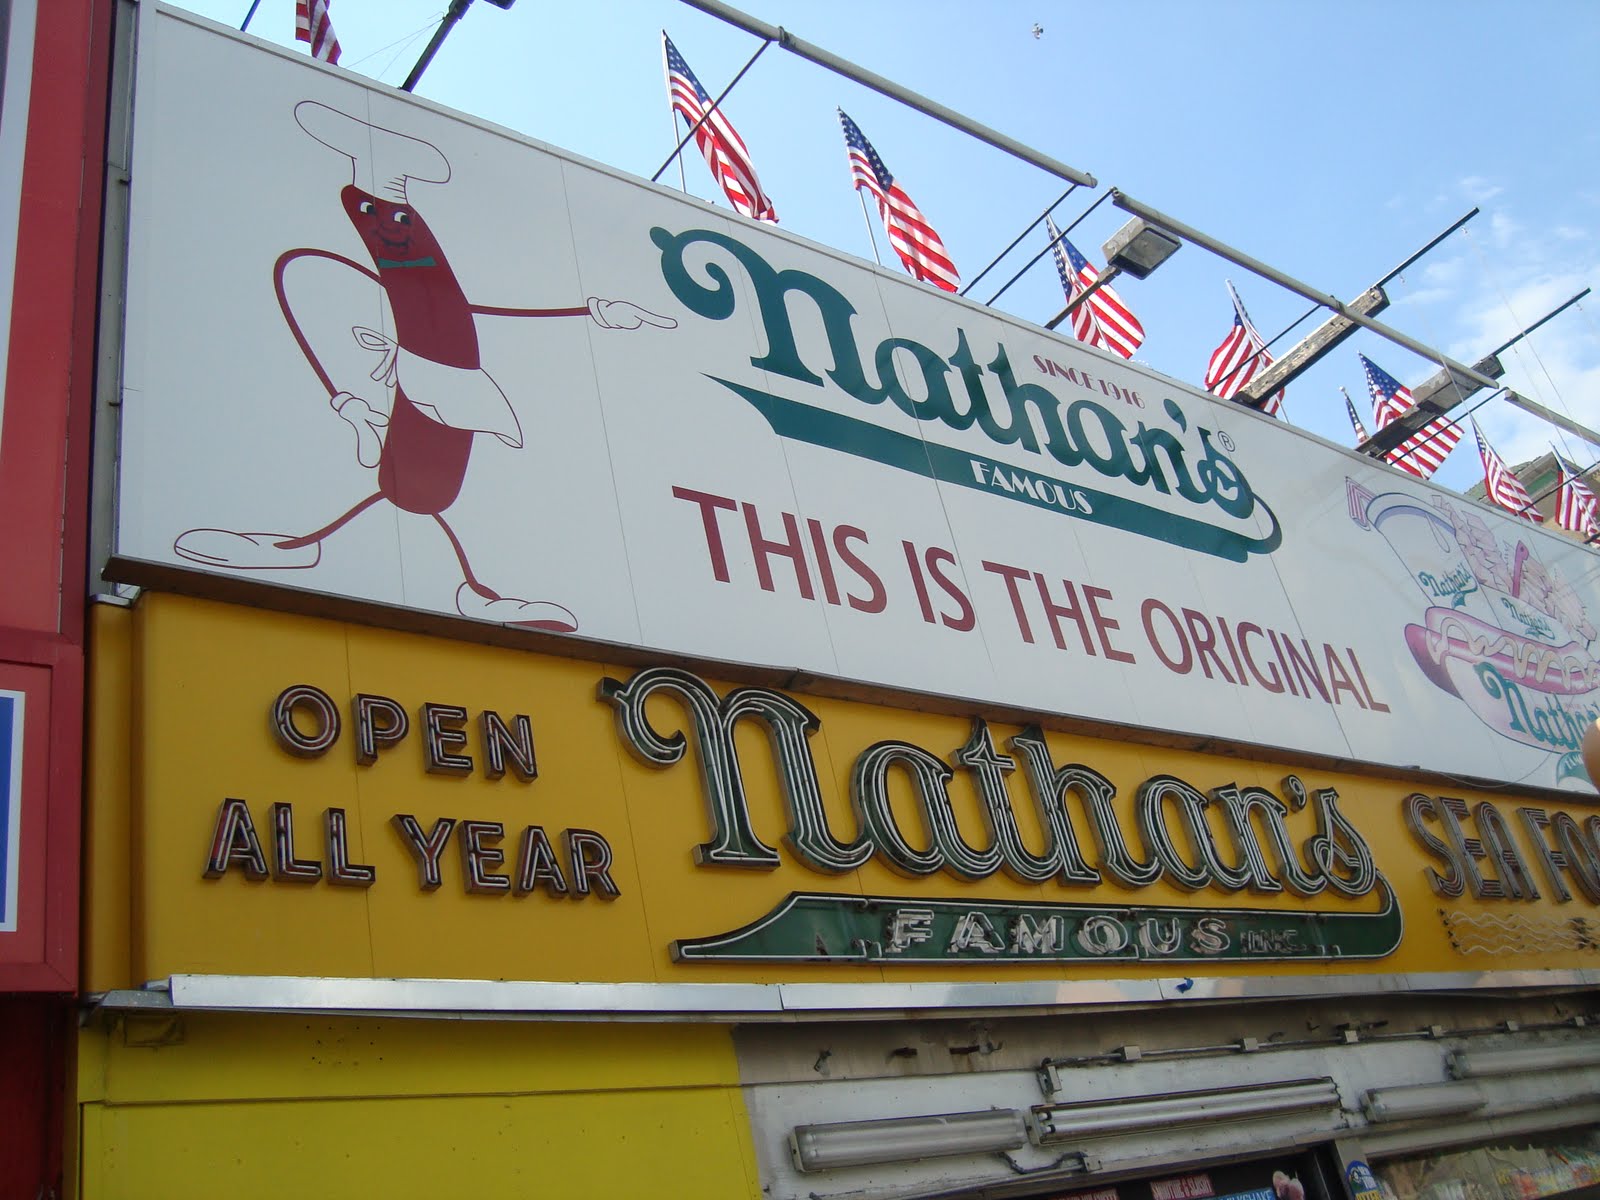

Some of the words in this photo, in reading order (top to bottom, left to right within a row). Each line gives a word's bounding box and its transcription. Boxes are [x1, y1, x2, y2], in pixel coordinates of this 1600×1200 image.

[650, 226, 1255, 519] Nathan's
[1032, 354, 1098, 391] SINCE
[1098, 379, 1146, 409] 1916
[969, 459, 1093, 514] FAMOUS
[671, 485, 888, 614] THIS
[901, 539, 976, 633] IS
[981, 559, 1136, 665] THE
[1140, 598, 1391, 713] ORIGINAL
[271, 684, 538, 783] OPEN
[596, 667, 1380, 898] Nathan's
[202, 798, 376, 888] ALL
[389, 814, 622, 901] YEAR
[885, 908, 1231, 954] FAMOUS
